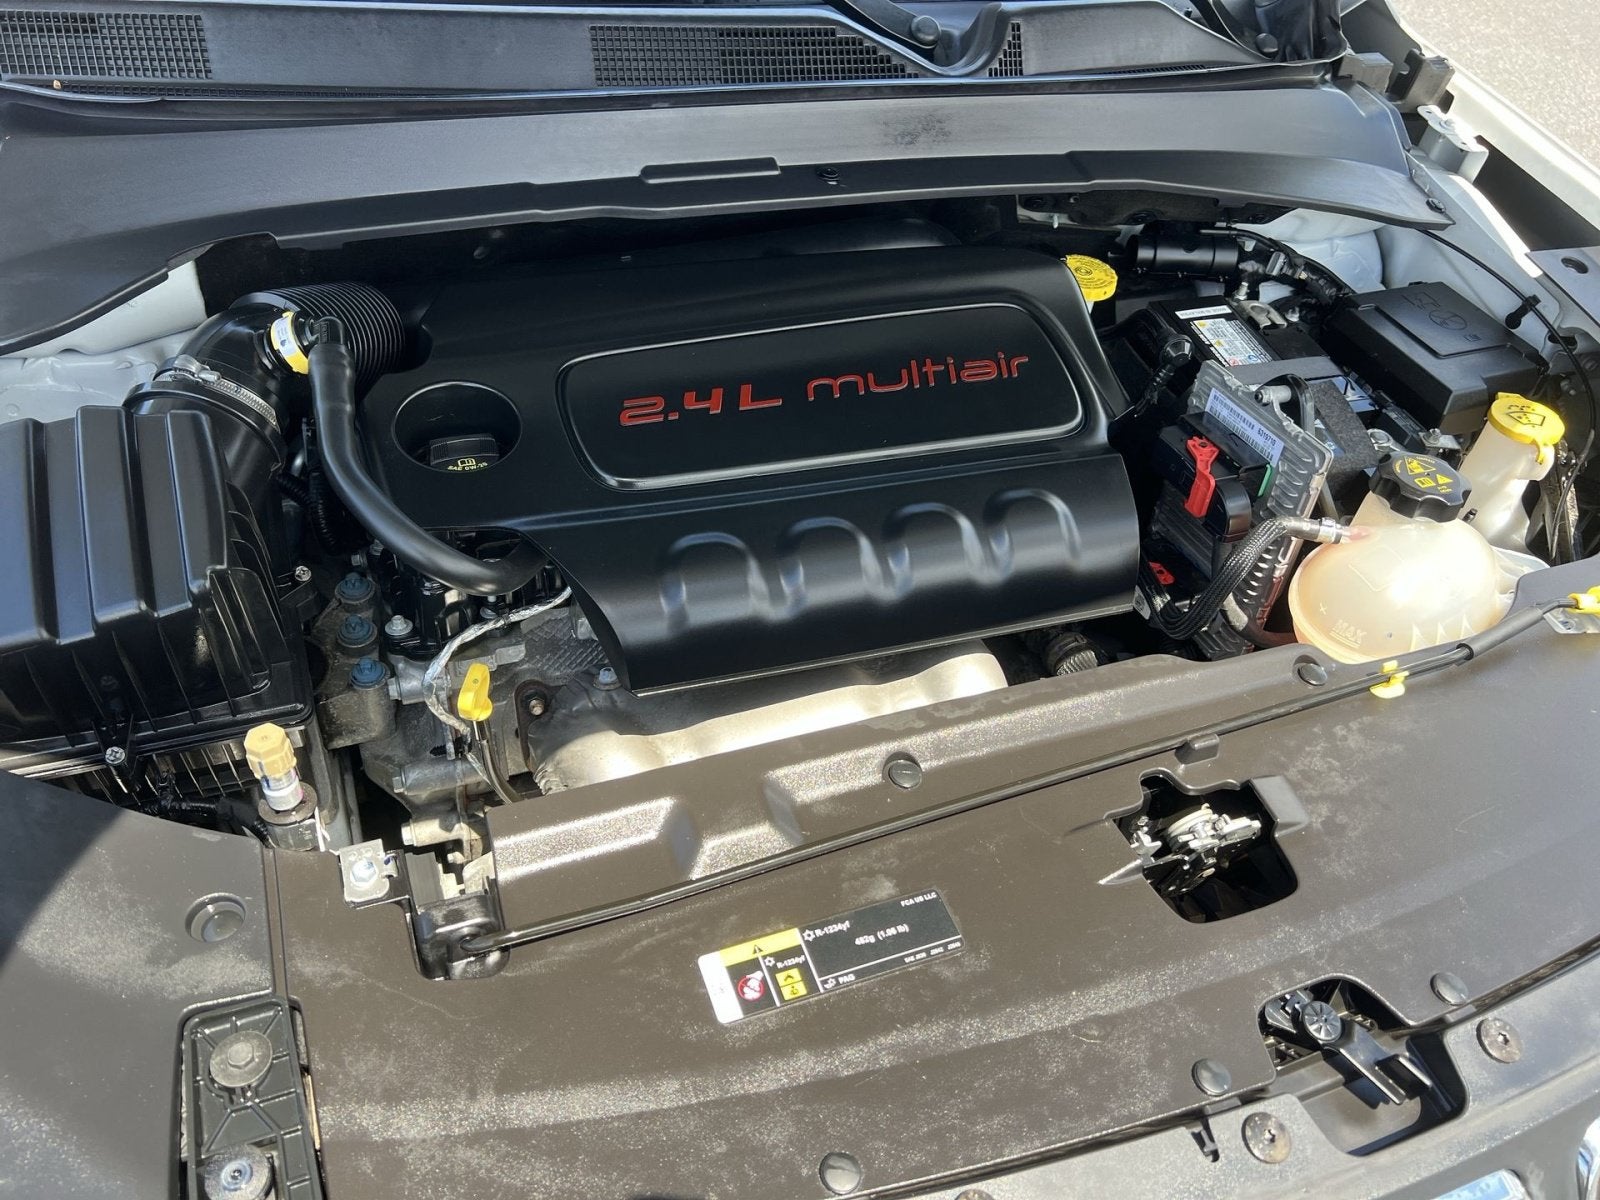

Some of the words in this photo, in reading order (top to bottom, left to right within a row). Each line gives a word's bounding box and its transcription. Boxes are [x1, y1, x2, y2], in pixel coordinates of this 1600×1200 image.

[806, 351, 1029, 402] multiair
[1332, 619, 1367, 644] MAX
[900, 898, 915, 907] FCA
[923, 891, 938, 901] LLC
[814, 920, 851, 938] R-1234yf
